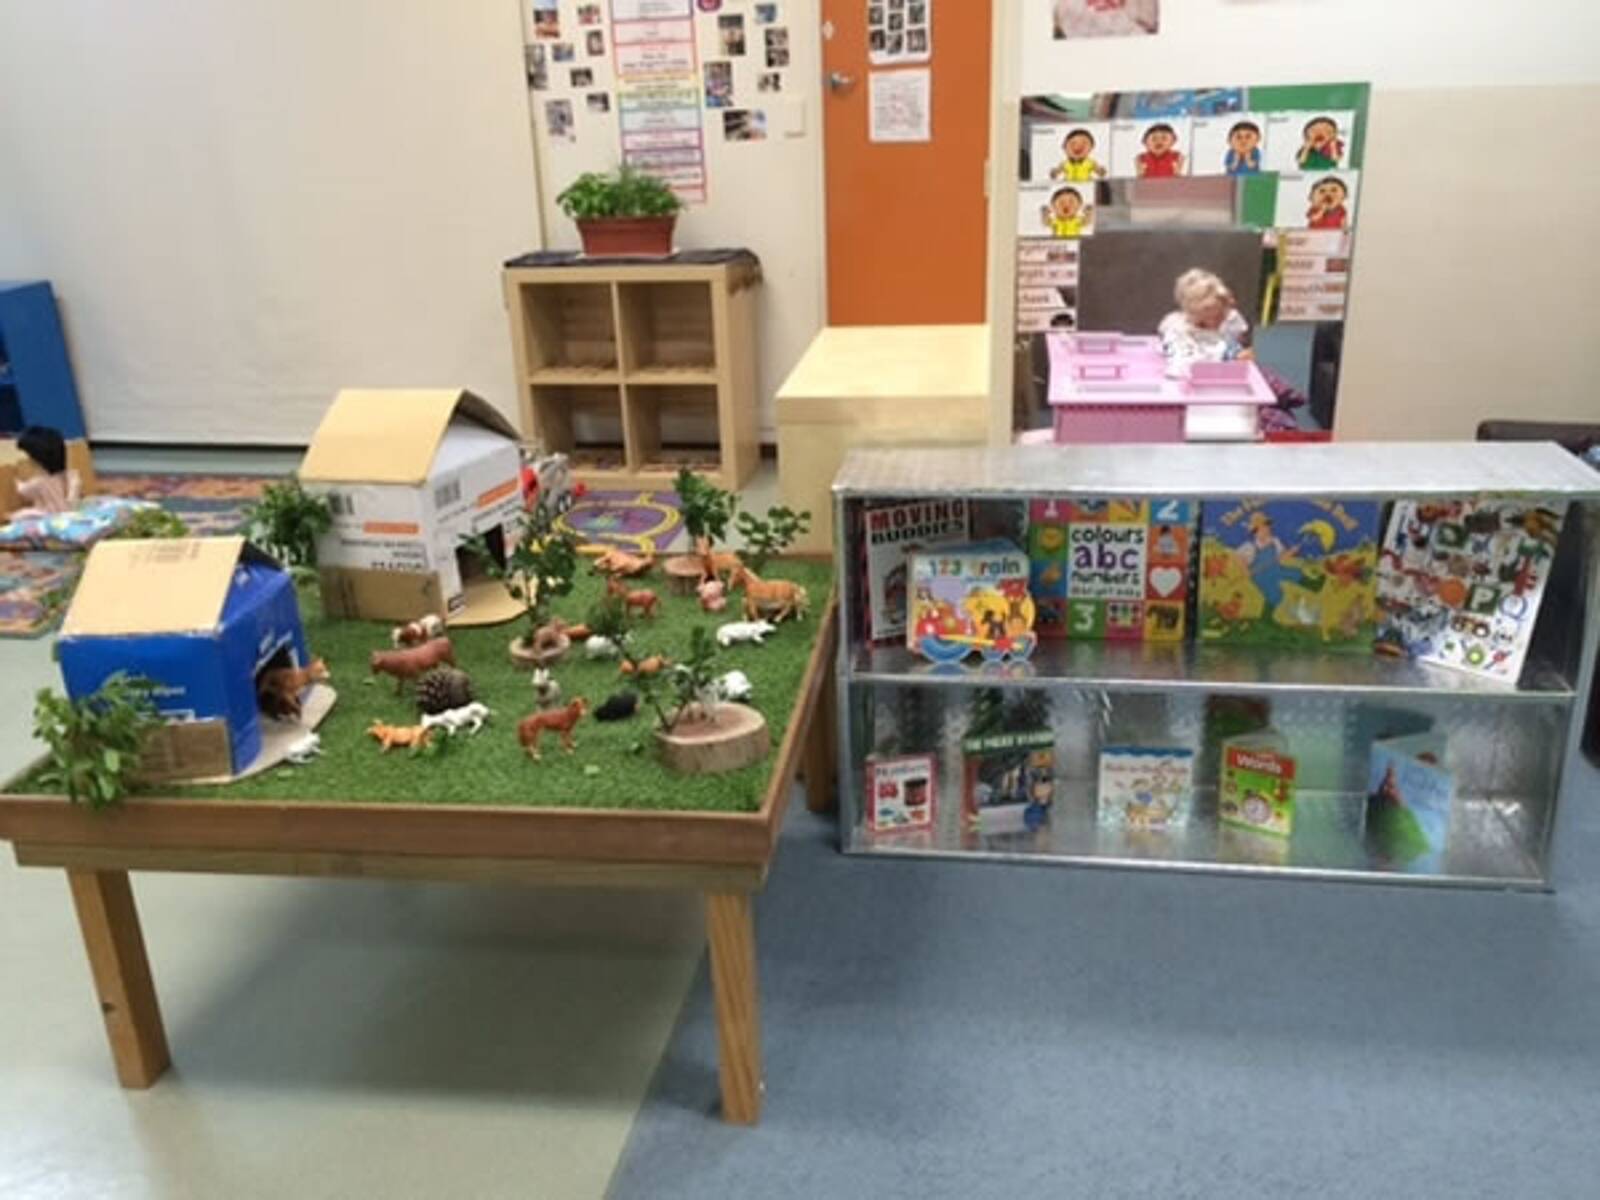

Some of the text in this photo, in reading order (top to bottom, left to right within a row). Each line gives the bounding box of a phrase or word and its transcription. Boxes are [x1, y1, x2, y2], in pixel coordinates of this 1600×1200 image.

[870, 499, 963, 532] MOVING
[872, 520, 963, 545] BUDDIES
[1071, 526, 1144, 544] colours
[929, 559, 962, 578] 123
[1074, 543, 1139, 570] abc
[1074, 603, 1096, 632] 3
